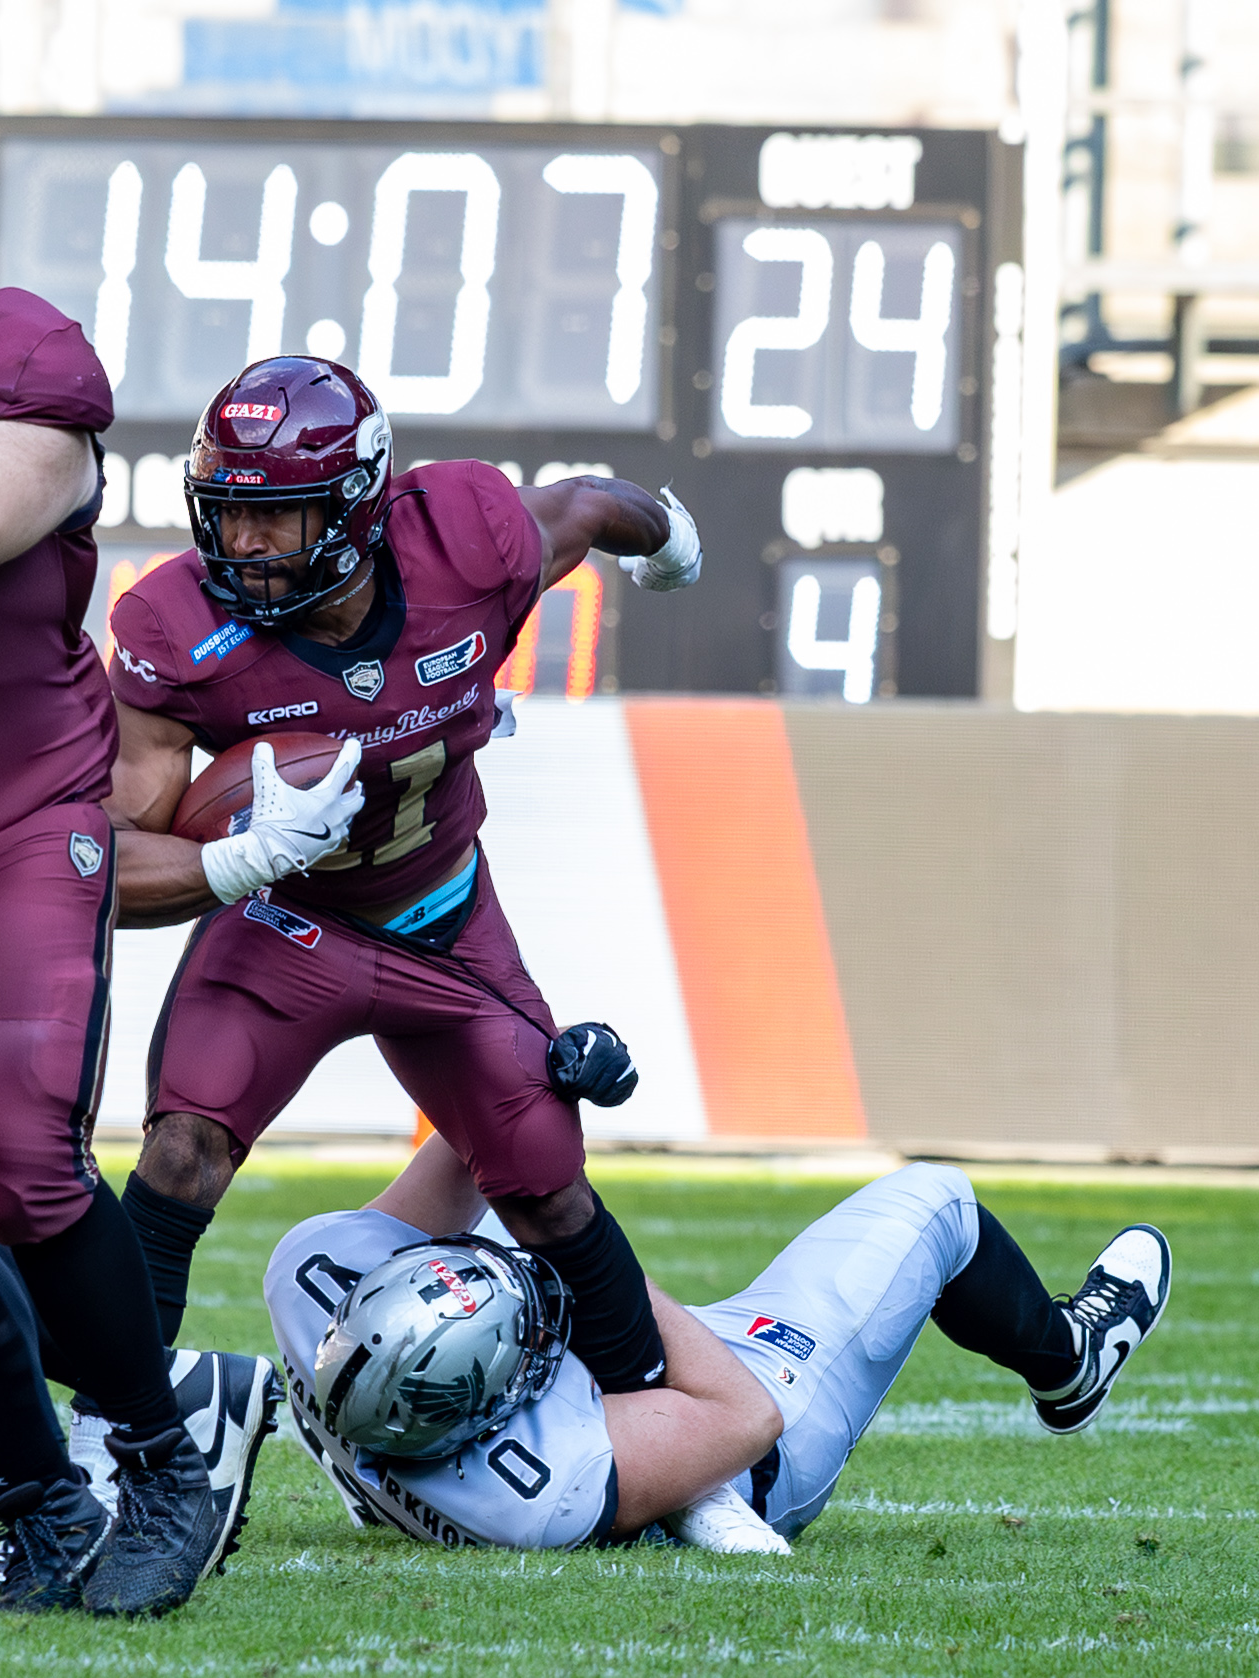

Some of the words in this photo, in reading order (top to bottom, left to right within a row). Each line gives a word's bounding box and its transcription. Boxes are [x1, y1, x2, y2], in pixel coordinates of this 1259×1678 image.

[93, 152, 659, 414] 14:07
[720, 227, 955, 439] 24
[193, 623, 237, 661] DUISBURG
[217, 641, 230, 655] IST
[230, 627, 251, 646] ECHT
[788, 575, 881, 704] 4
[423, 651, 458, 669] EUROPEAN
[424, 661, 450, 674] LEAGUE
[426, 665, 459, 680] FOOTBALL
[396, 683, 479, 735] Pilsener
[774, 1338, 807, 1359] EUROPEAN
[784, 1328, 814, 1349] FOOTBALL
[487, 1437, 552, 1501] 0
